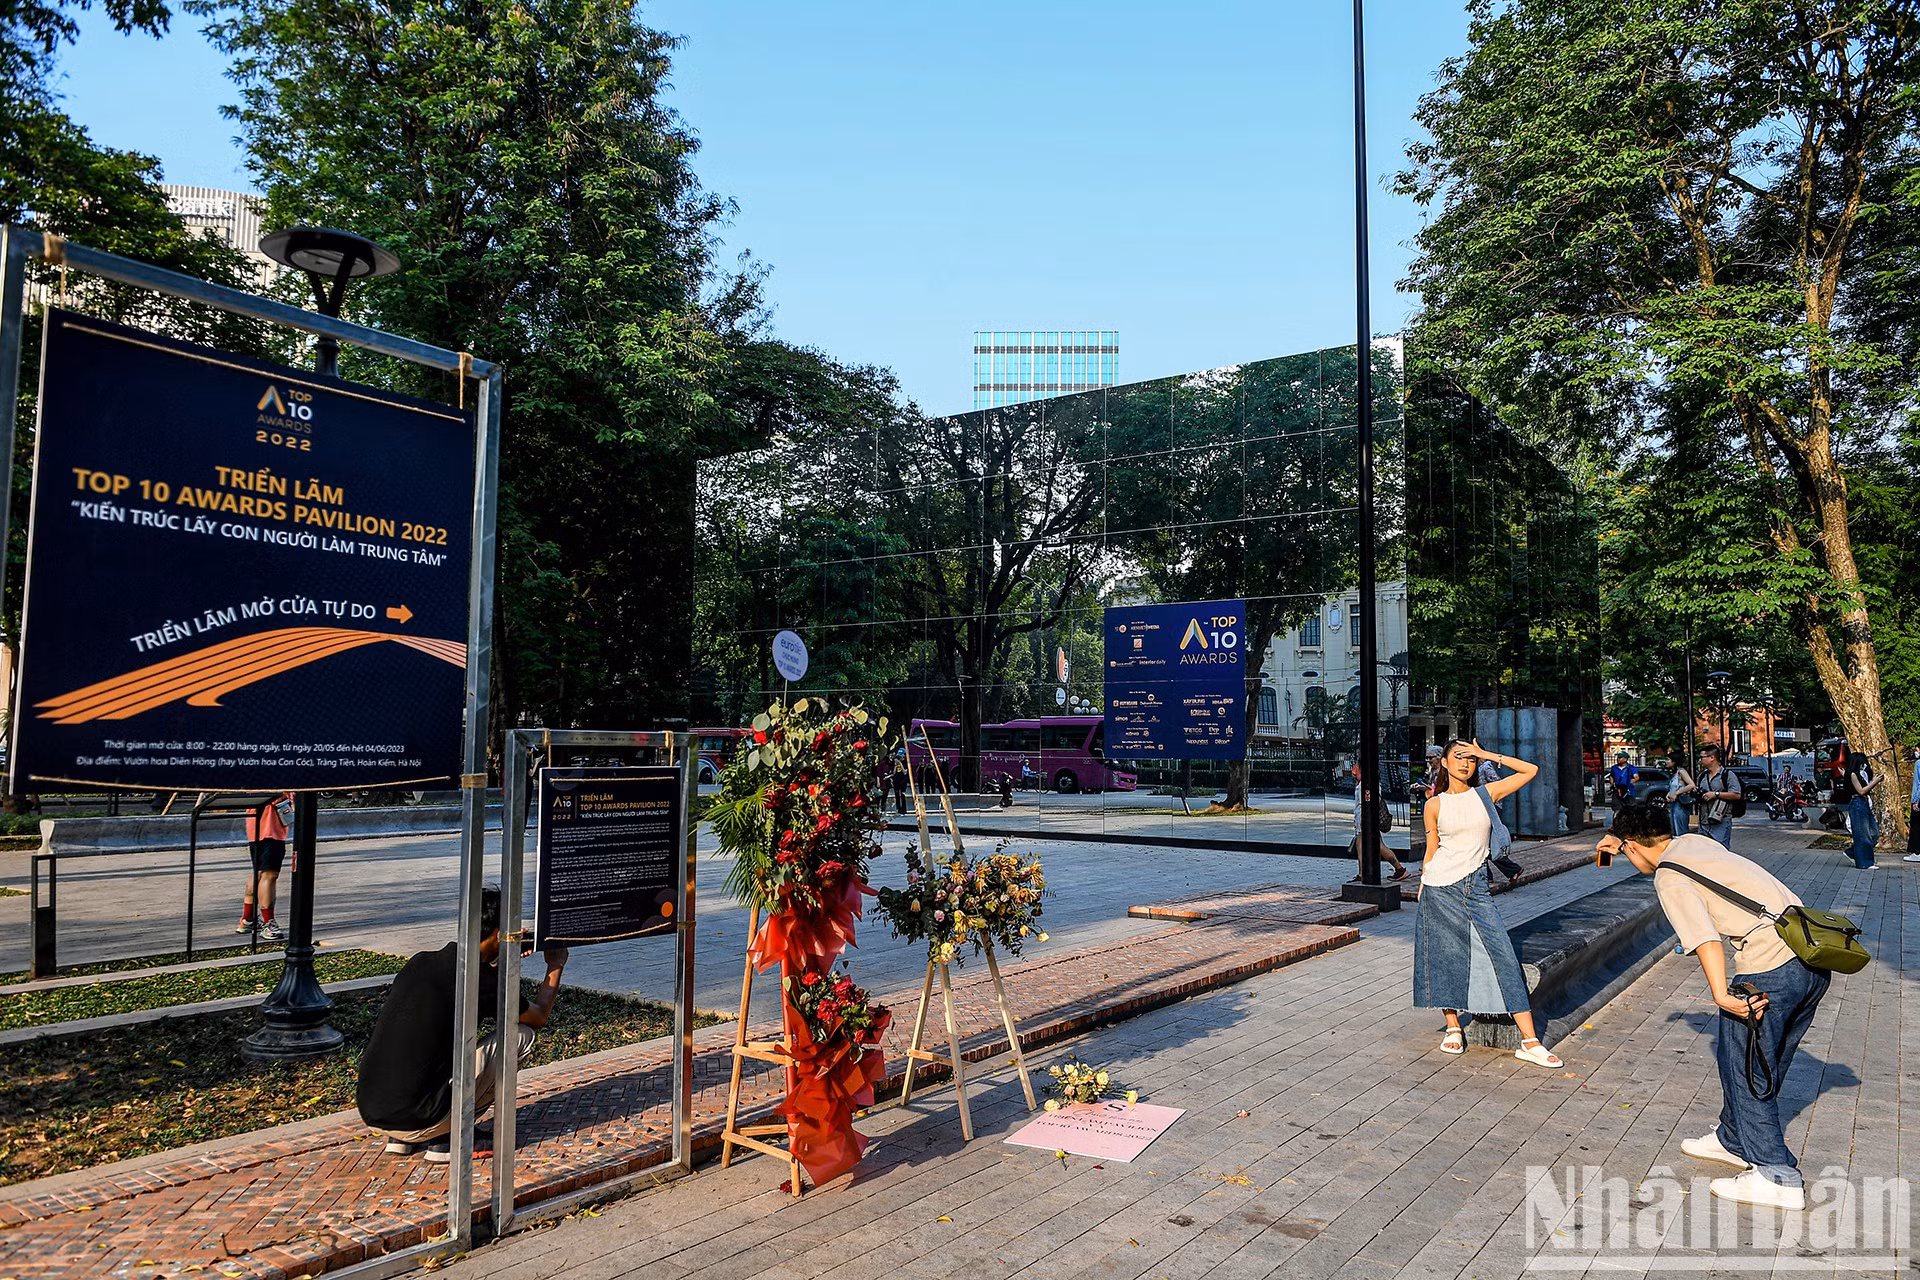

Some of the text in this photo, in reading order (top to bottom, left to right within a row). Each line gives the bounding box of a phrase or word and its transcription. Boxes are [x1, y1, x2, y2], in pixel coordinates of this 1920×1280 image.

[167, 196, 231, 217] Bank
[288, 389, 313, 403] TOP
[287, 402, 313, 421] 10
[256, 414, 312, 434] AWARDS
[255, 430, 311, 451] 2022
[215, 465, 344, 506] TRIỂN LÃM
[72, 467, 448, 546] TOP 10 AWARDS PAVILION 2022
[129, 510, 180, 531] TRÚC
[183, 515, 218, 535] LẤY
[220, 523, 259, 541] CON
[263, 528, 318, 549] NGƯỜI
[321, 535, 355, 555] LÀM
[358, 542, 408, 562] TRUNG
[130, 594, 377, 652] TRIỂN LÃM MỞ CỬA TỰ DO
[1210, 616, 1237, 628] TOP
[1210, 631, 1237, 649] 10
[1180, 652, 1238, 665] AWARDS
[126, 741, 147, 752] gian
[149, 741, 164, 749] mở
[186, 741, 204, 750] 8:00
[212, 742, 236, 750] 22:00
[237, 742, 258, 753] hàng
[293, 744, 311, 753] ngày
[313, 743, 335, 752] 20/05
[336, 744, 350, 752] đến
[351, 744, 364, 752] hết
[365, 744, 405, 753] 04/06/2023
[150, 757, 168, 765] hoa
[217, 757, 236, 768] (hay
[237, 757, 260, 766] Vườn
[261, 757, 277, 766] hoa
[278, 758, 294, 766] Con
[317, 758, 337, 768] Tràng
[357, 759, 376, 767] Hoàn
[398, 759, 408, 767] Hà
[409, 758, 422, 767] Nội
[580, 803, 593, 811] TOP
[602, 802, 629, 810] AWARDS
[656, 800, 670, 808] 2022
